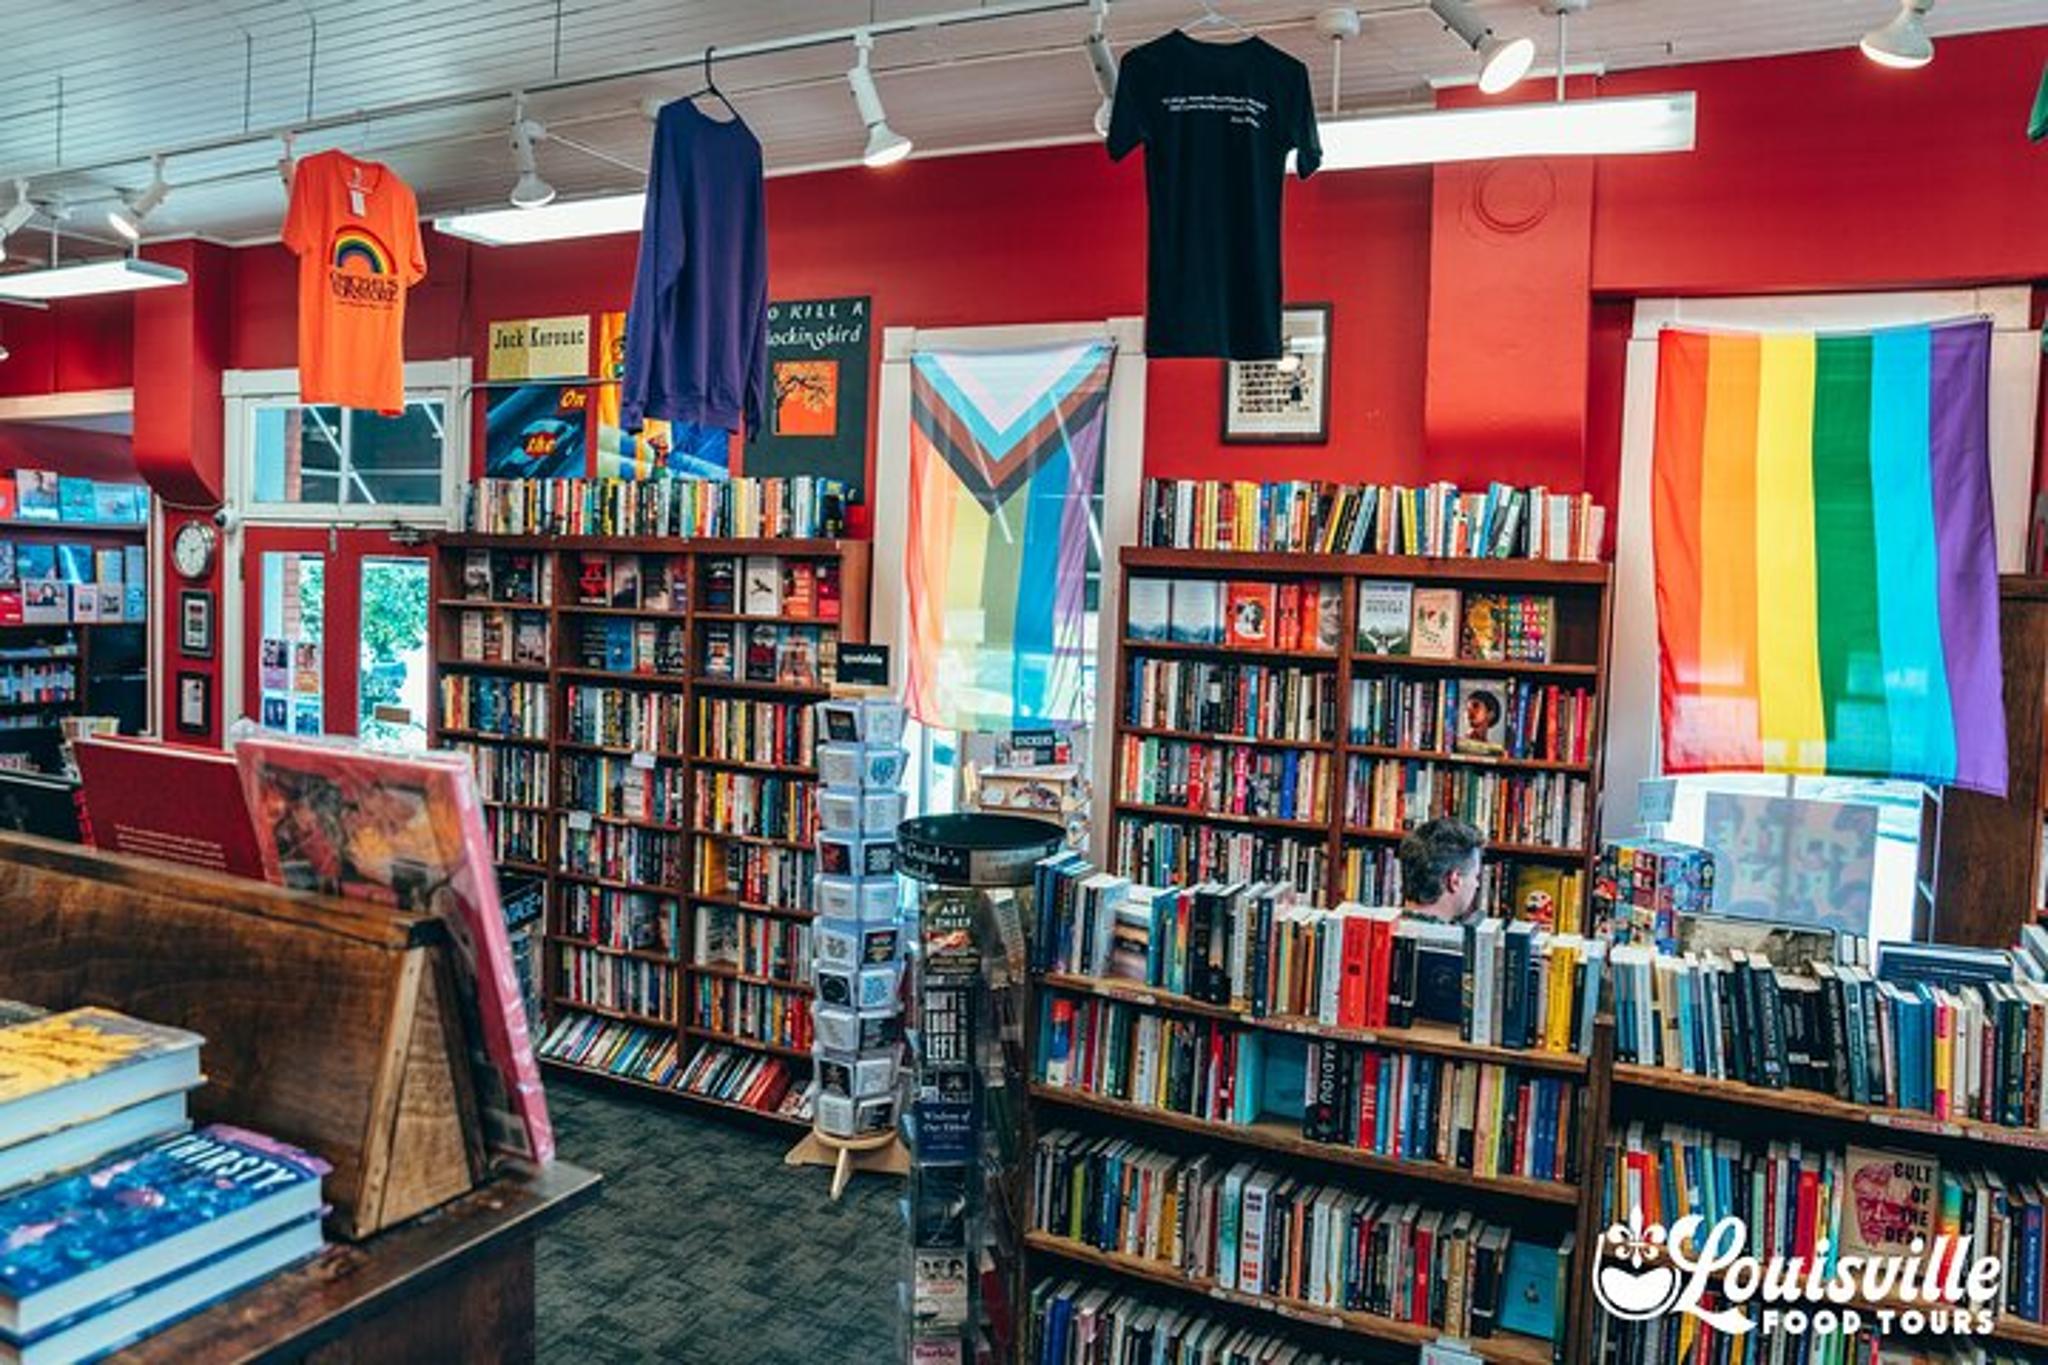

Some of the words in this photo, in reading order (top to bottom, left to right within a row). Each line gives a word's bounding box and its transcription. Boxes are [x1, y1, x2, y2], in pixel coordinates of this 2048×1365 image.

[790, 304, 836, 319] KILL
[852, 301, 863, 315] A
[494, 329, 524, 349] Jack
[530, 326, 585, 347] Kerouac
[766, 323, 863, 350] ockingbird
[561, 388, 587, 408] On
[526, 434, 556, 455] the
[941, 905, 966, 916] ART
[935, 917, 972, 928] THIEF
[926, 1034, 957, 1059] LEFT
[156, 1134, 298, 1191] THIRSTY
[1894, 1162, 1932, 1183] CULT
[1911, 1185, 1931, 1205] OF
[1901, 1205, 1929, 1228] THE
